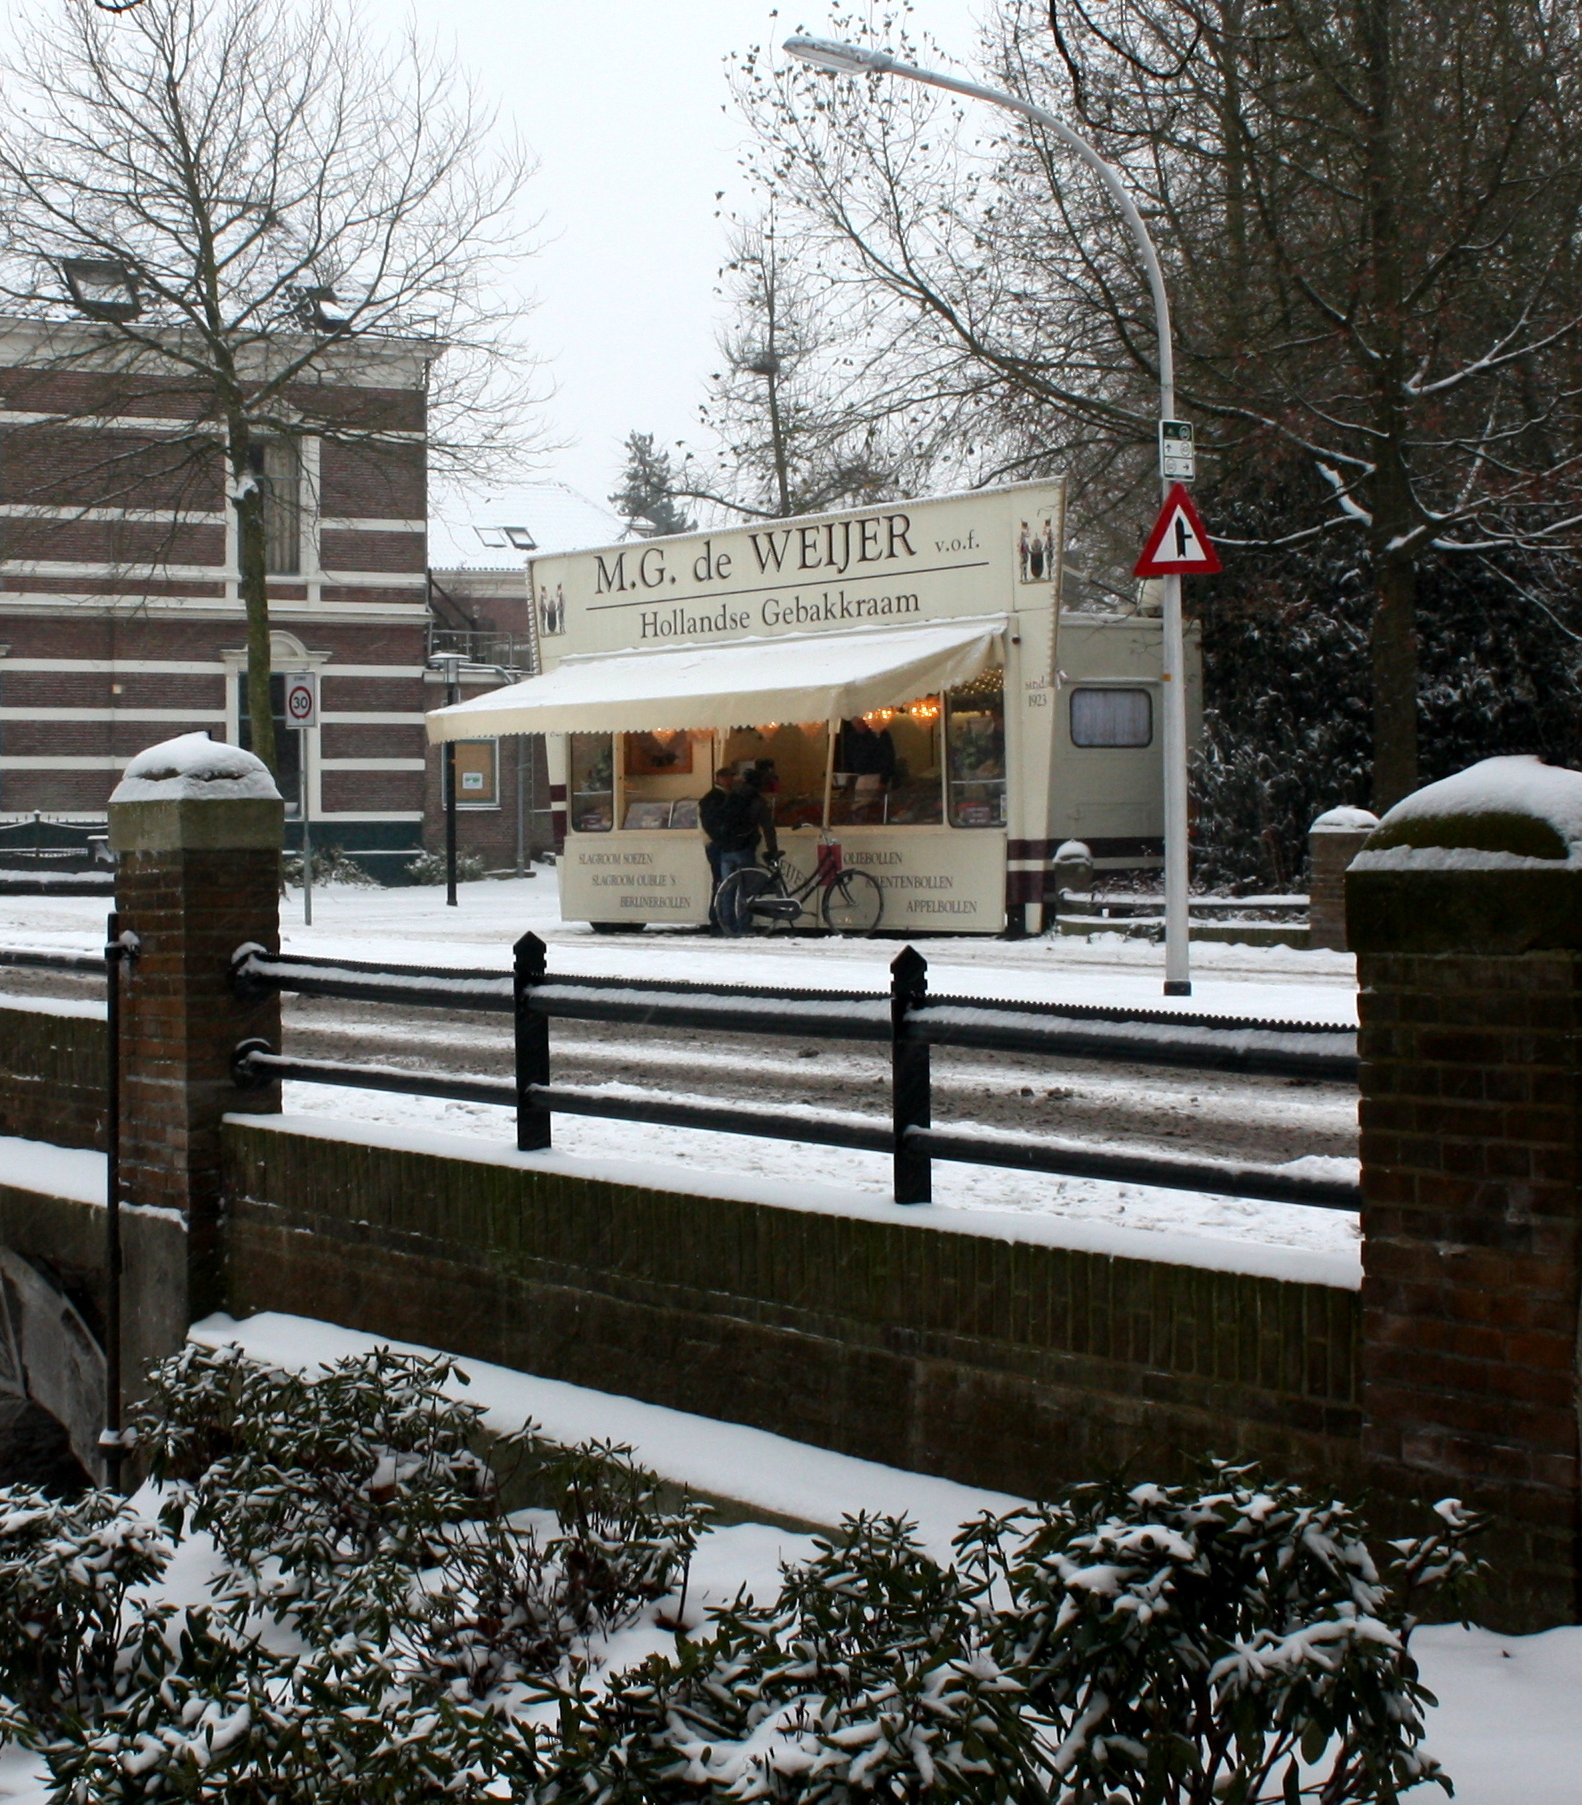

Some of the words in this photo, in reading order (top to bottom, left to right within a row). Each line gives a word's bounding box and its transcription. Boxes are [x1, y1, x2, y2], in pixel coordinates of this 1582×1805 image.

[594, 547, 676, 595] M.G.
[693, 540, 732, 583] de
[748, 513, 917, 575] WEIJER
[935, 529, 980, 553] v.o.f.
[640, 603, 750, 639] Hollandse
[761, 590, 921, 627] Gebakkraam
[293, 696, 308, 709] 30
[1028, 694, 1047, 707] 1923
[844, 852, 903, 865] OLIEBOLLEN
[907, 901, 977, 914] APPELBOLLEN
